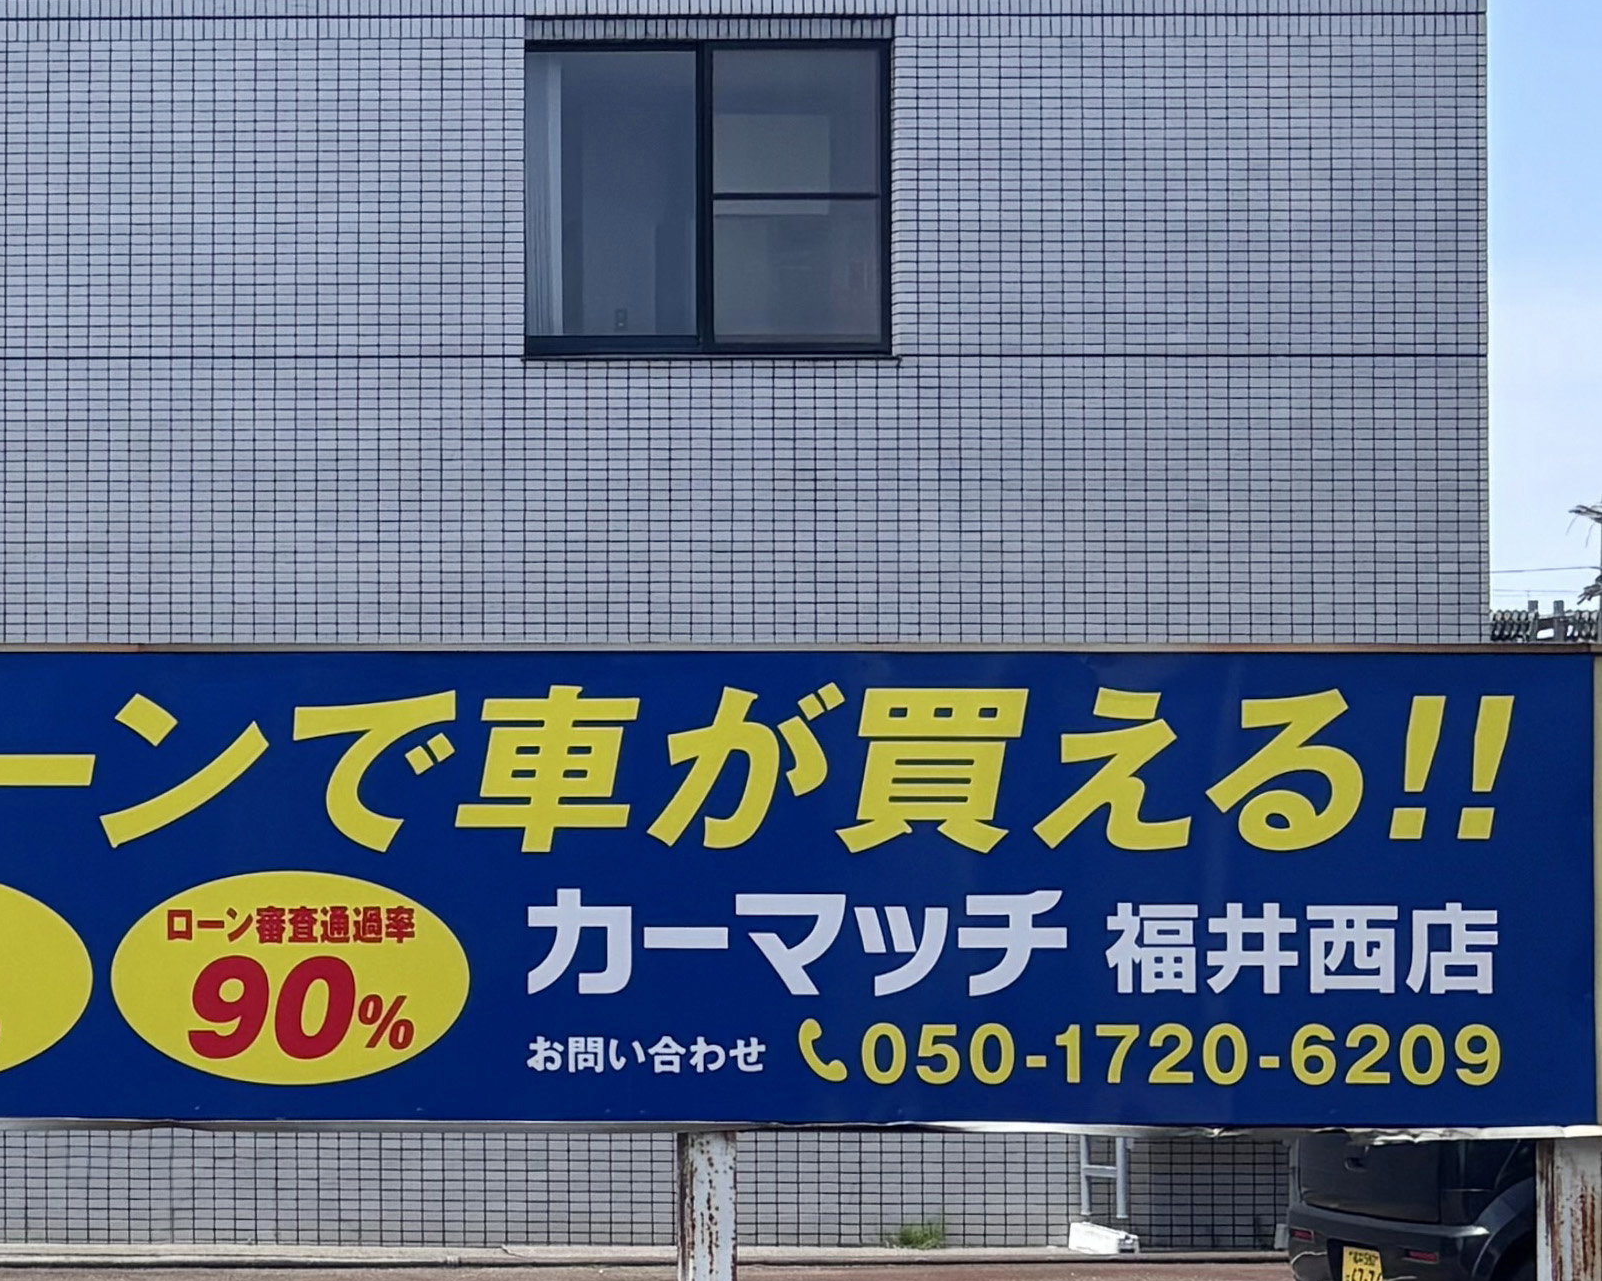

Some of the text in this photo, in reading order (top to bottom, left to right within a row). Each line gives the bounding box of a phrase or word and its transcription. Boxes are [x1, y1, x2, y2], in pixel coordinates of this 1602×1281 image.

[166, 905, 416, 944] ローン審査通過率
[527, 887, 1501, 998] カーマッチ 福井西店
[186, 955, 416, 1061] 90%
[525, 1021, 1502, 1087] お問い合わせ 050-1720-6209
